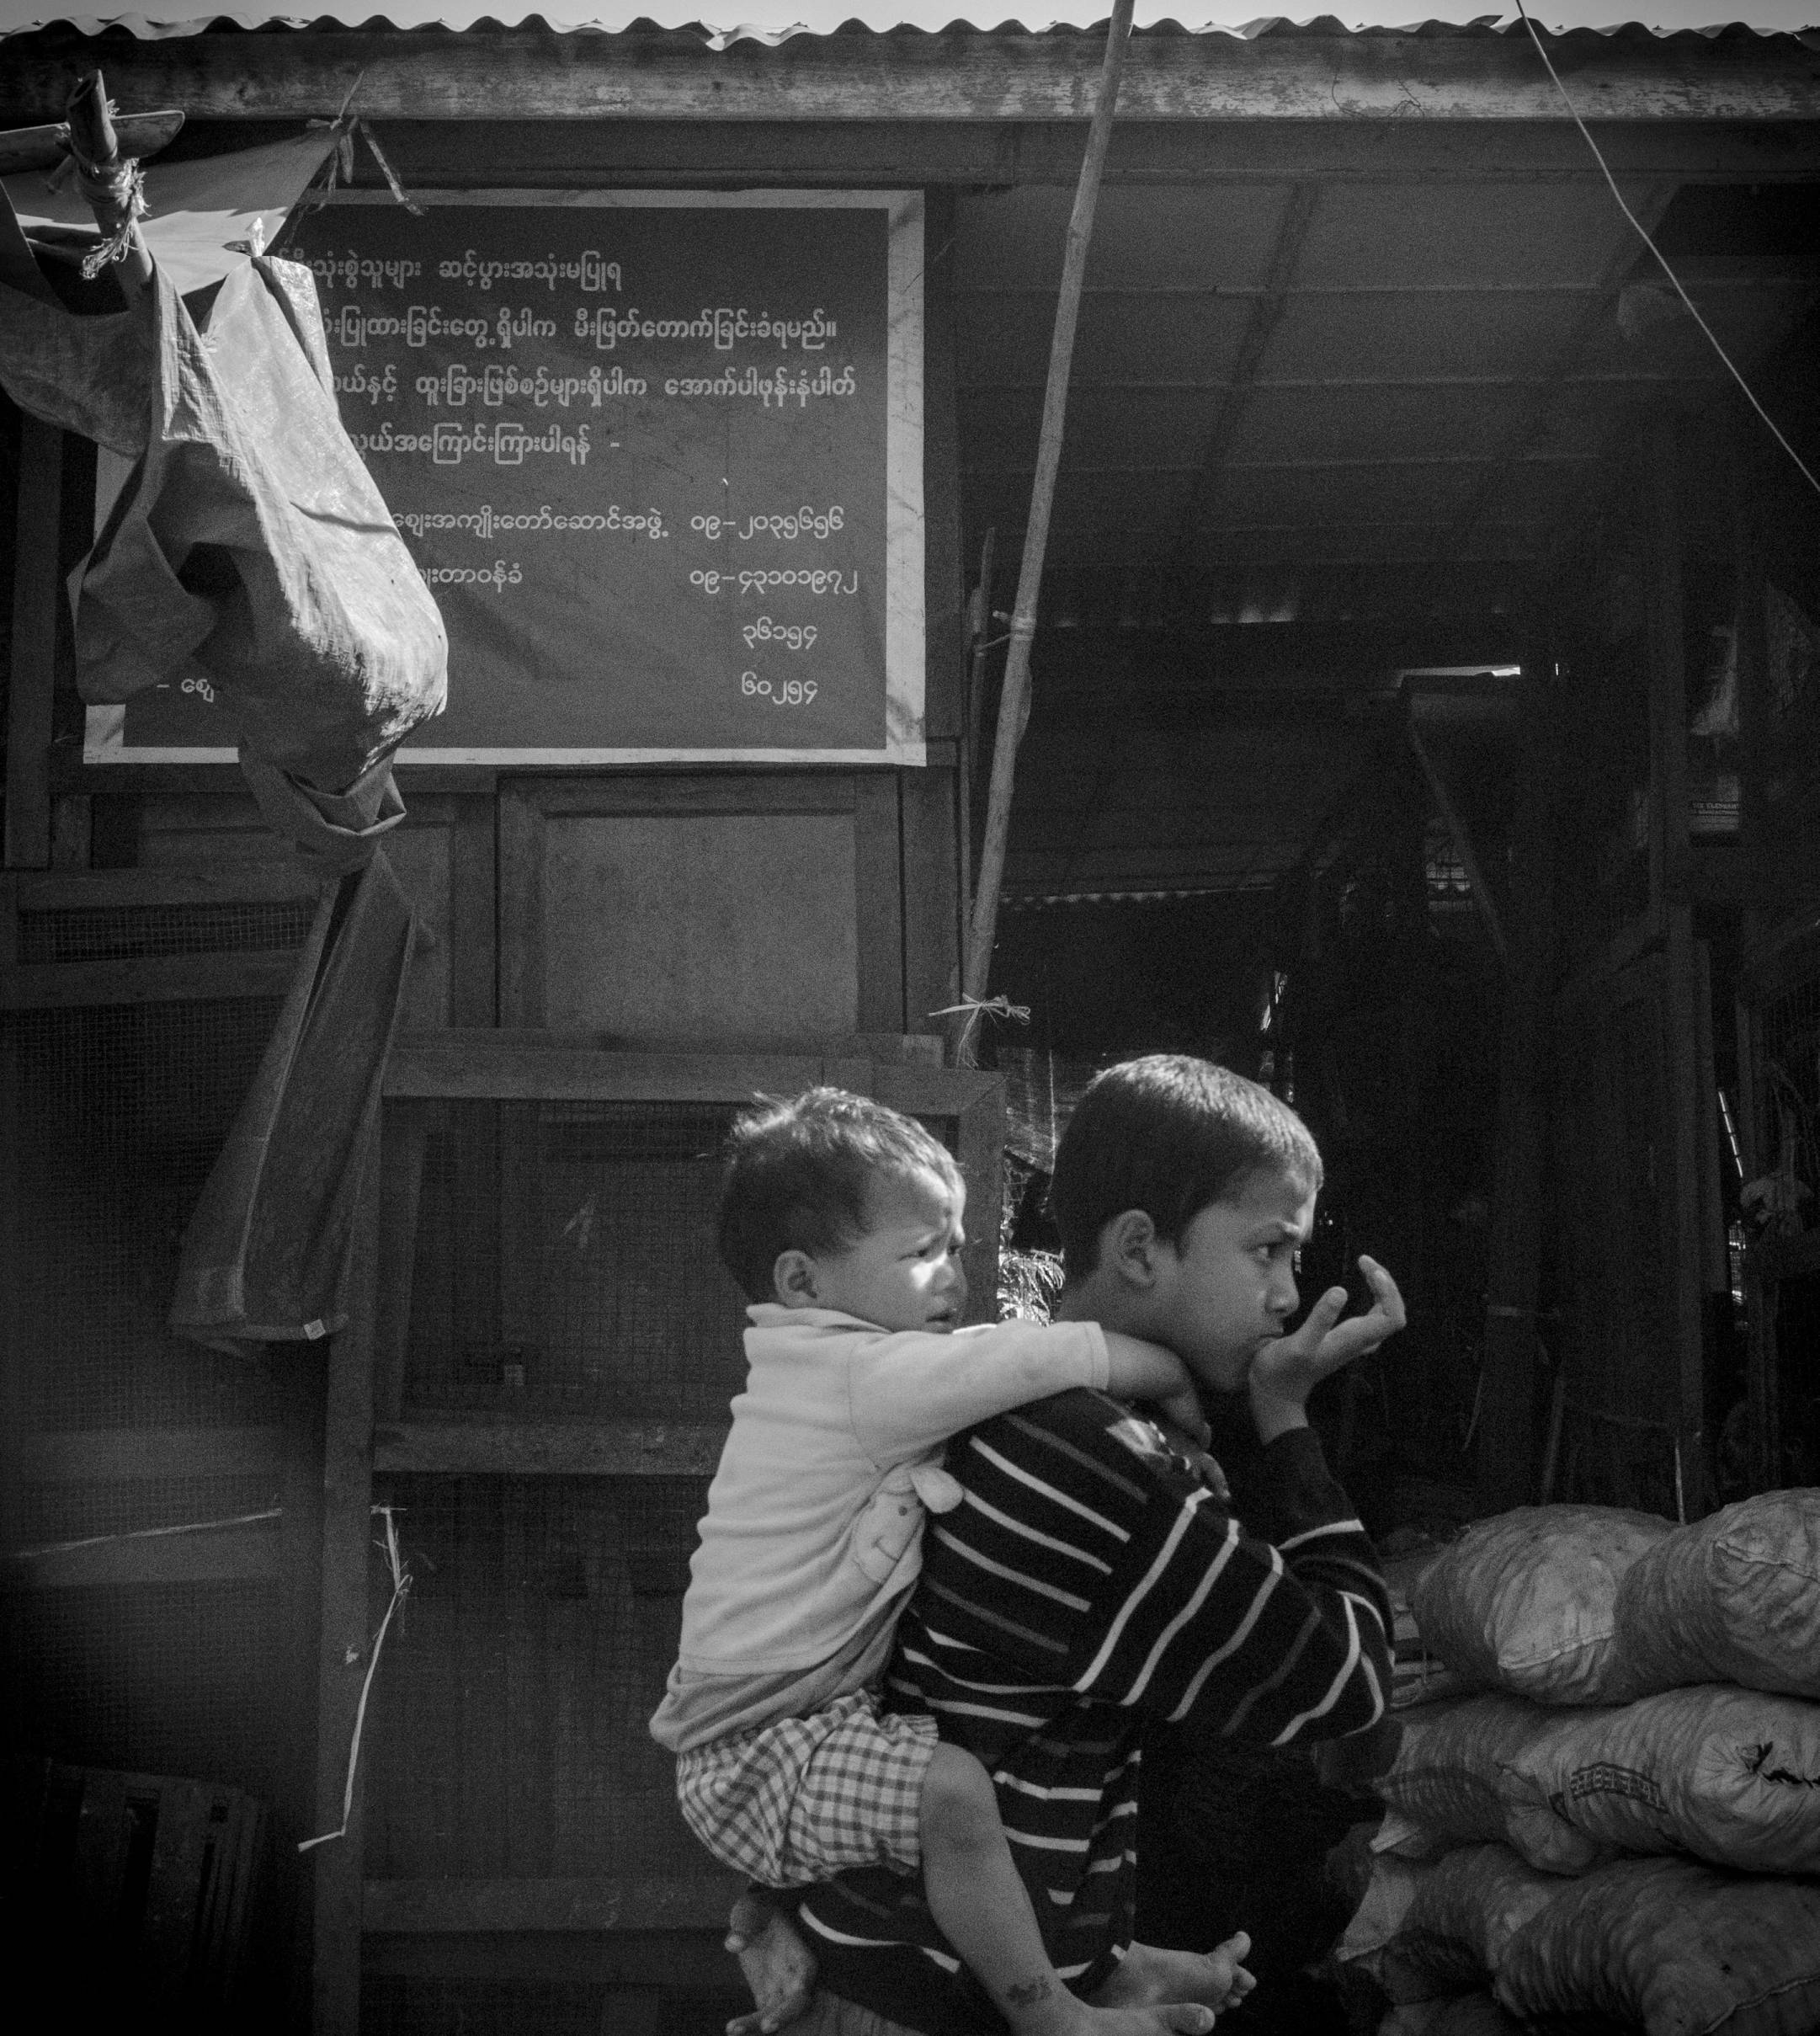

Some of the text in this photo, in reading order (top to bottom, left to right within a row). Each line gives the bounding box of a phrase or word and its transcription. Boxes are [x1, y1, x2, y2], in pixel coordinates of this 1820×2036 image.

[664, 365, 856, 408] အောက်ပါဖုန်းနံပါတ်
[742, 616, 818, 650] ၃၆၁၅၄
[742, 671, 818, 705] ၆၀၂၅၄
